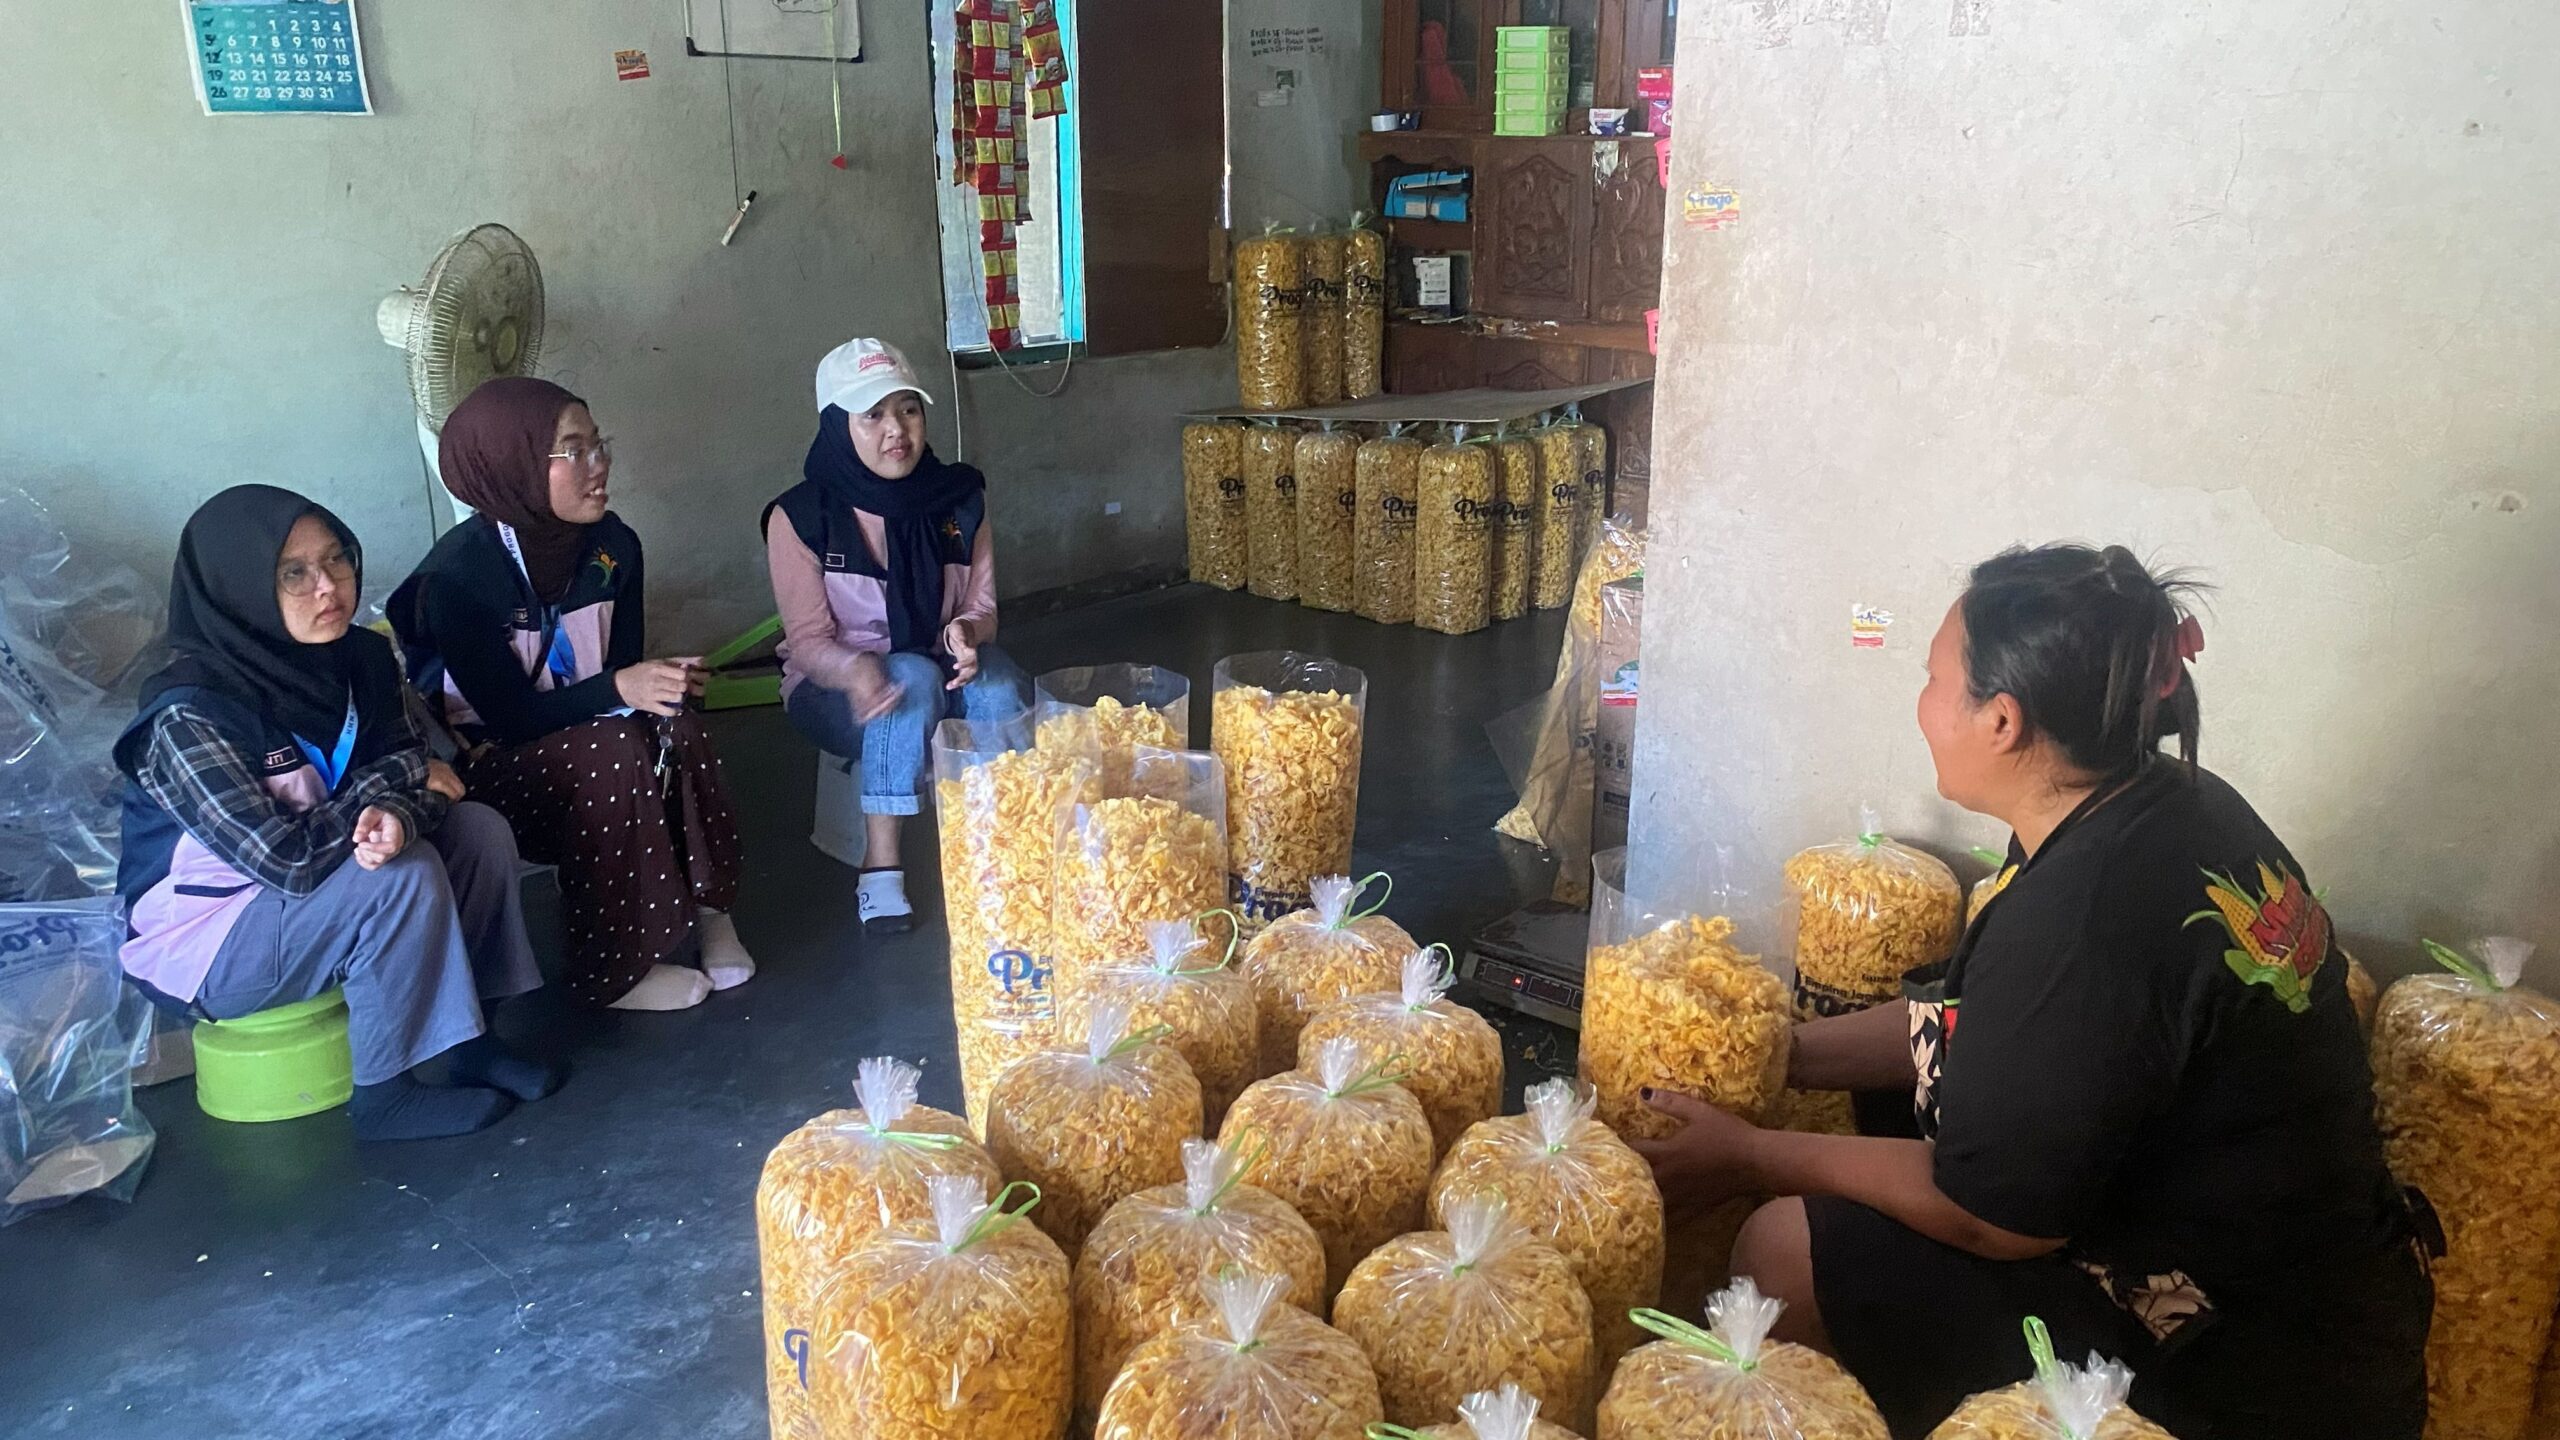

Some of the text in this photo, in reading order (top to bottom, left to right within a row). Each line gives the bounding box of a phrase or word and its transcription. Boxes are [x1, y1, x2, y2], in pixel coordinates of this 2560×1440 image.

[269, 20, 341, 32] 1 2 3 4
[227, 35, 237, 47] 6
[249, 35, 258, 47] 7
[271, 36, 280, 48] 8
[292, 36, 301, 48] 9
[311, 37, 327, 49] 10
[332, 38, 346, 49] 11
[205, 52, 350, 65] 12 13 14 15 16 17 18
[207, 69, 353, 82] 19 20 21 22 23 24 25
[210, 86, 334, 98] 26 27 28 29 30 31
